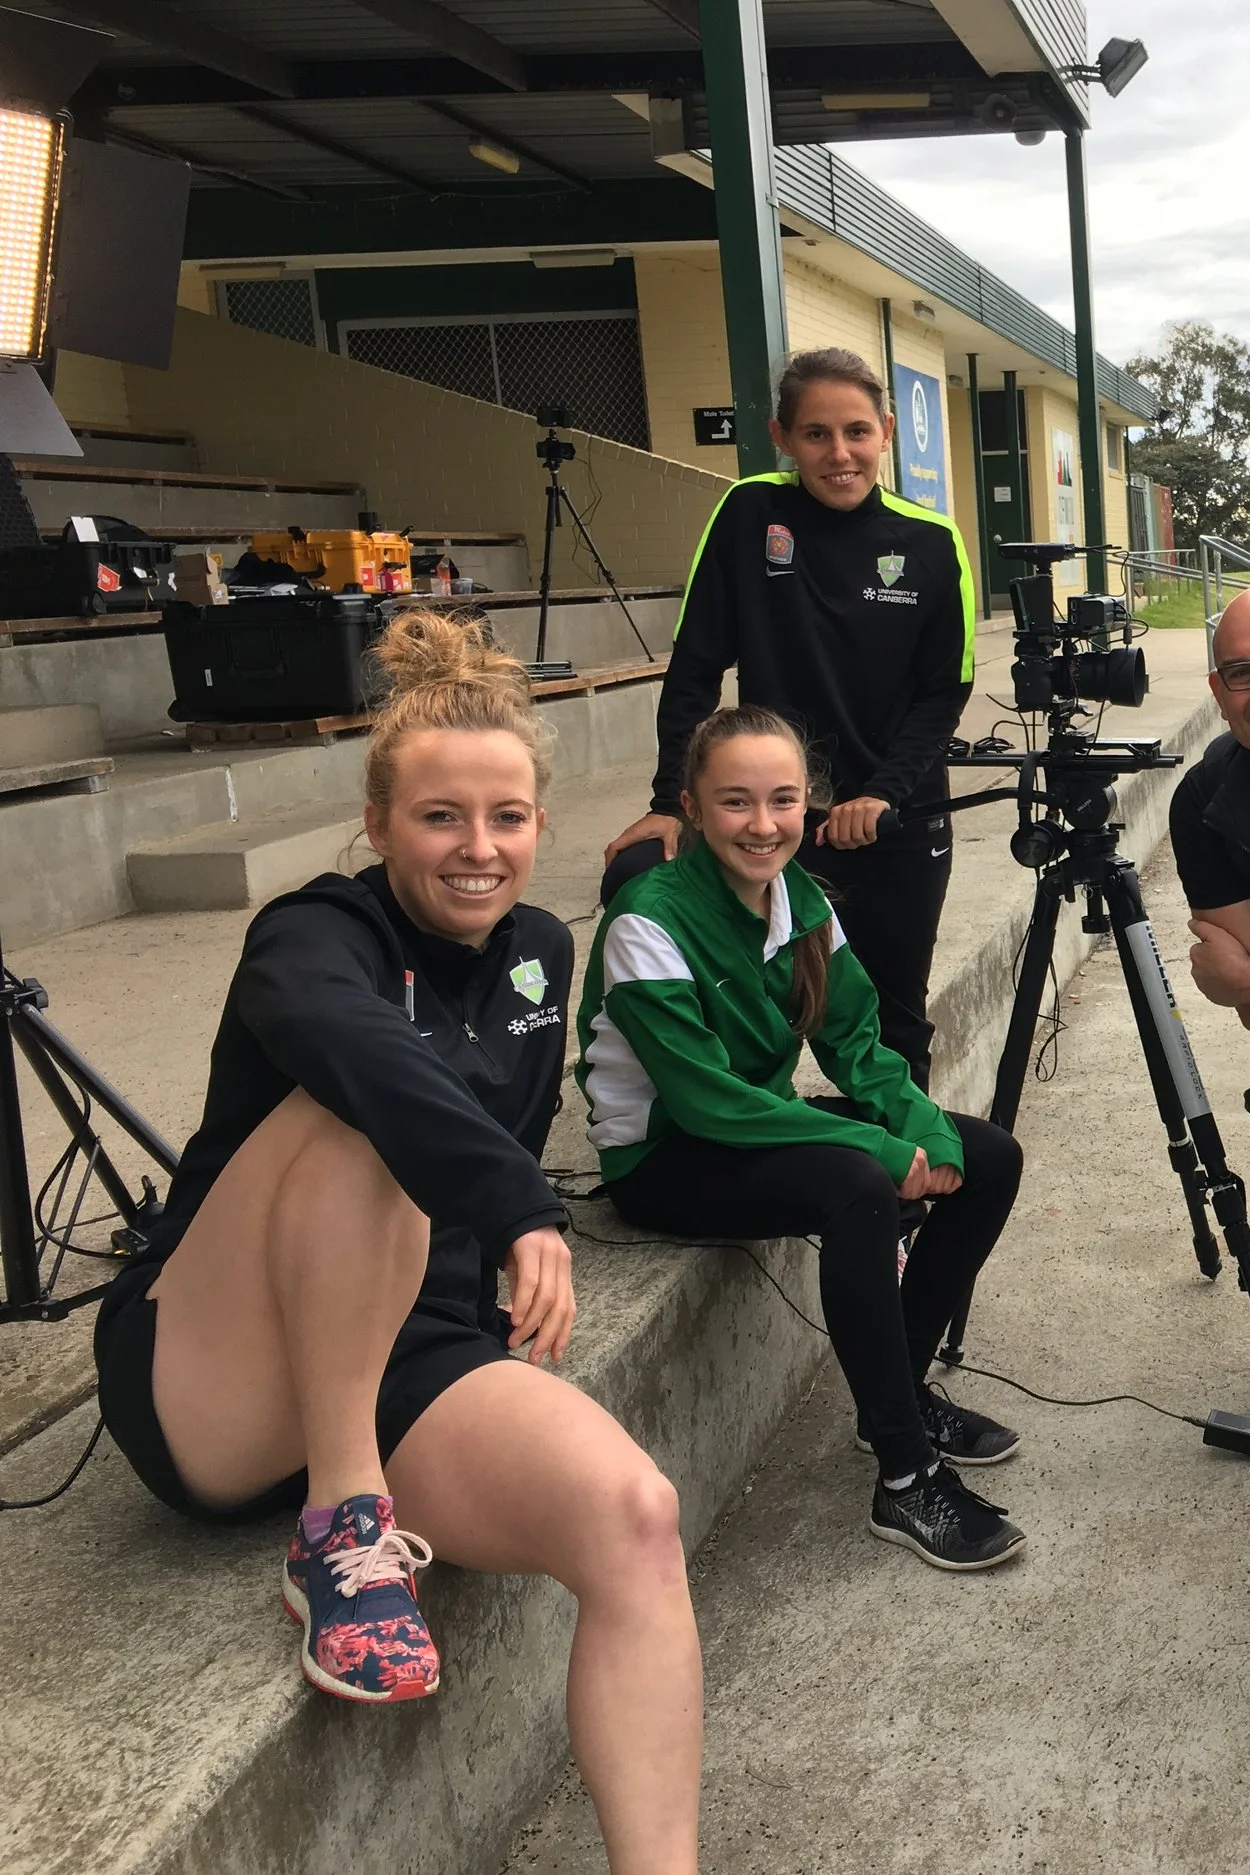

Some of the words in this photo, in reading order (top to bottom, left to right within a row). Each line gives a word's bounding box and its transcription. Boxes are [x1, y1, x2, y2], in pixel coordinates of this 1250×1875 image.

[877, 588, 911, 597] UNIVERSITY
[877, 594, 918, 605] CANBERRA
[547, 1005, 558, 1015] OF
